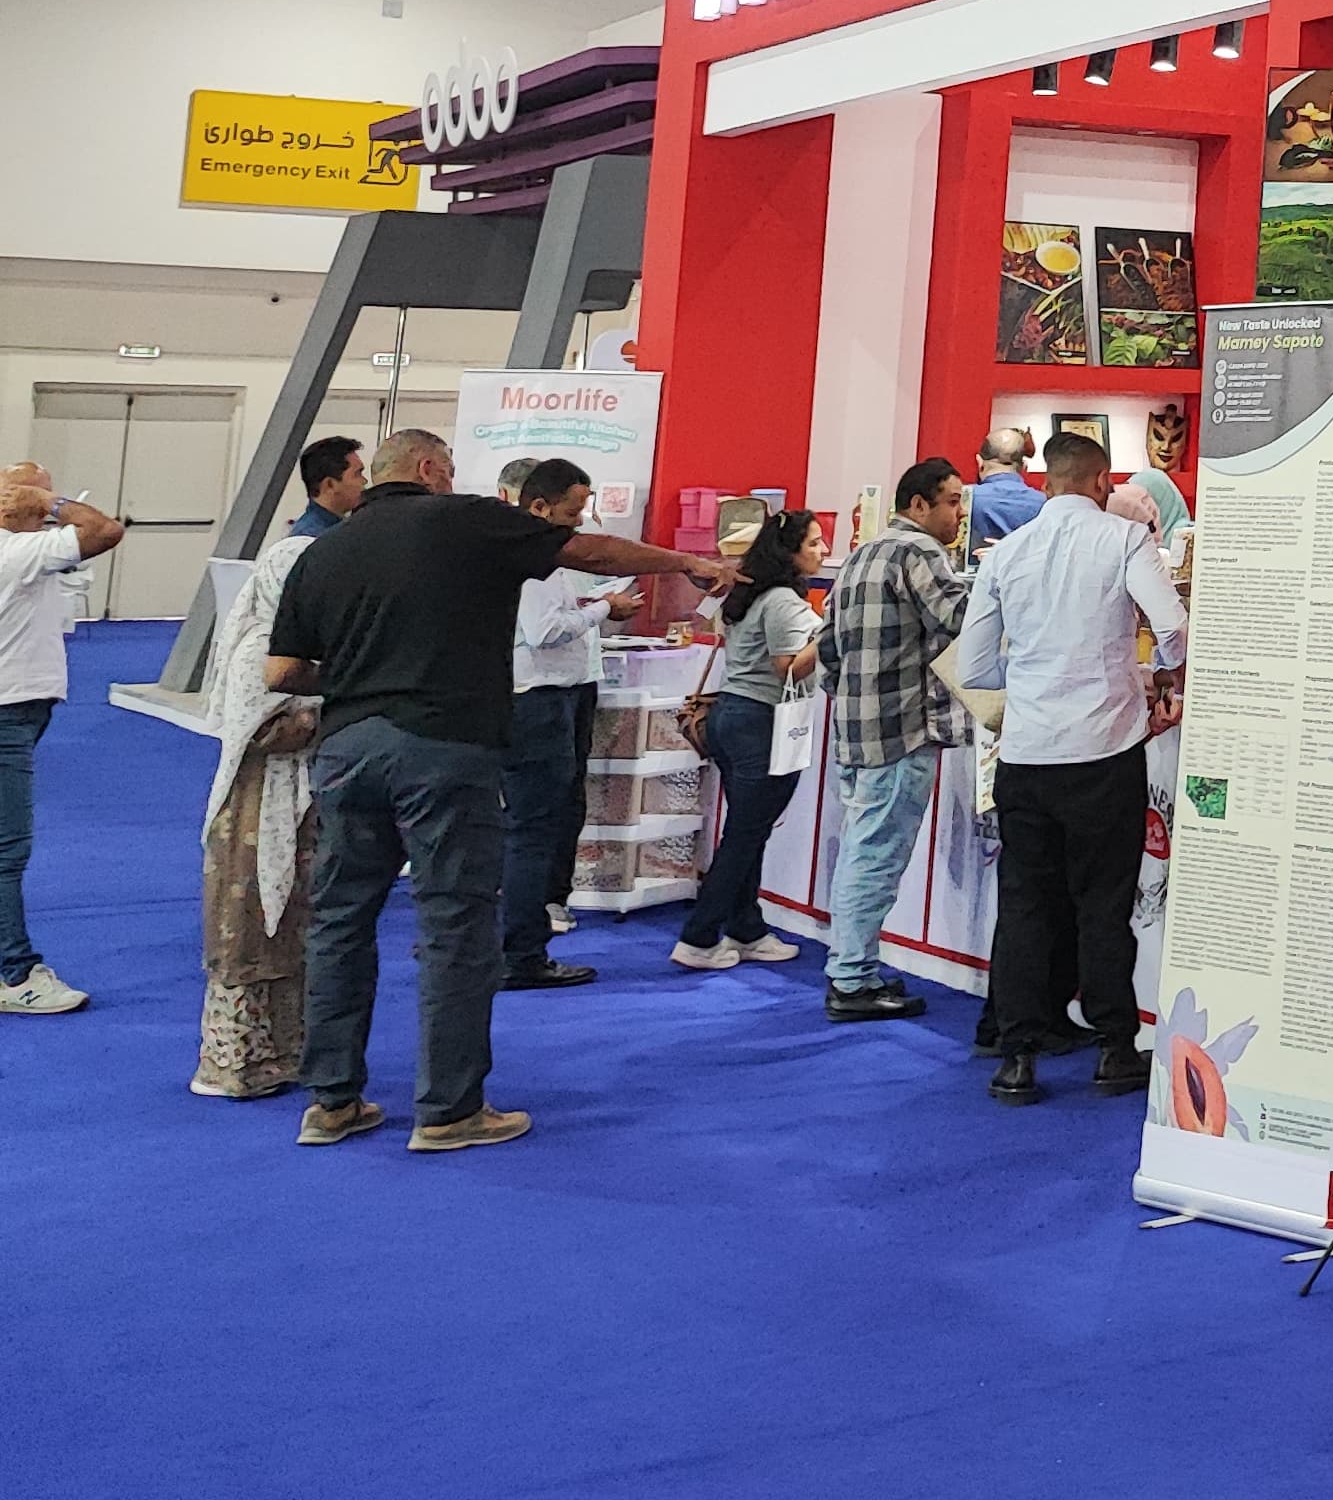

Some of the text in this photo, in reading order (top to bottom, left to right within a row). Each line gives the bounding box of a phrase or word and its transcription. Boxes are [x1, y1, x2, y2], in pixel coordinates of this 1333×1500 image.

[420, 37, 519, 153] odoo
[203, 122, 355, 150] خروج طوارئ
[200, 157, 350, 180] Emergency Exit
[1218, 316, 1322, 331] New Taste Unlocked
[500, 386, 618, 412] Moorlife
